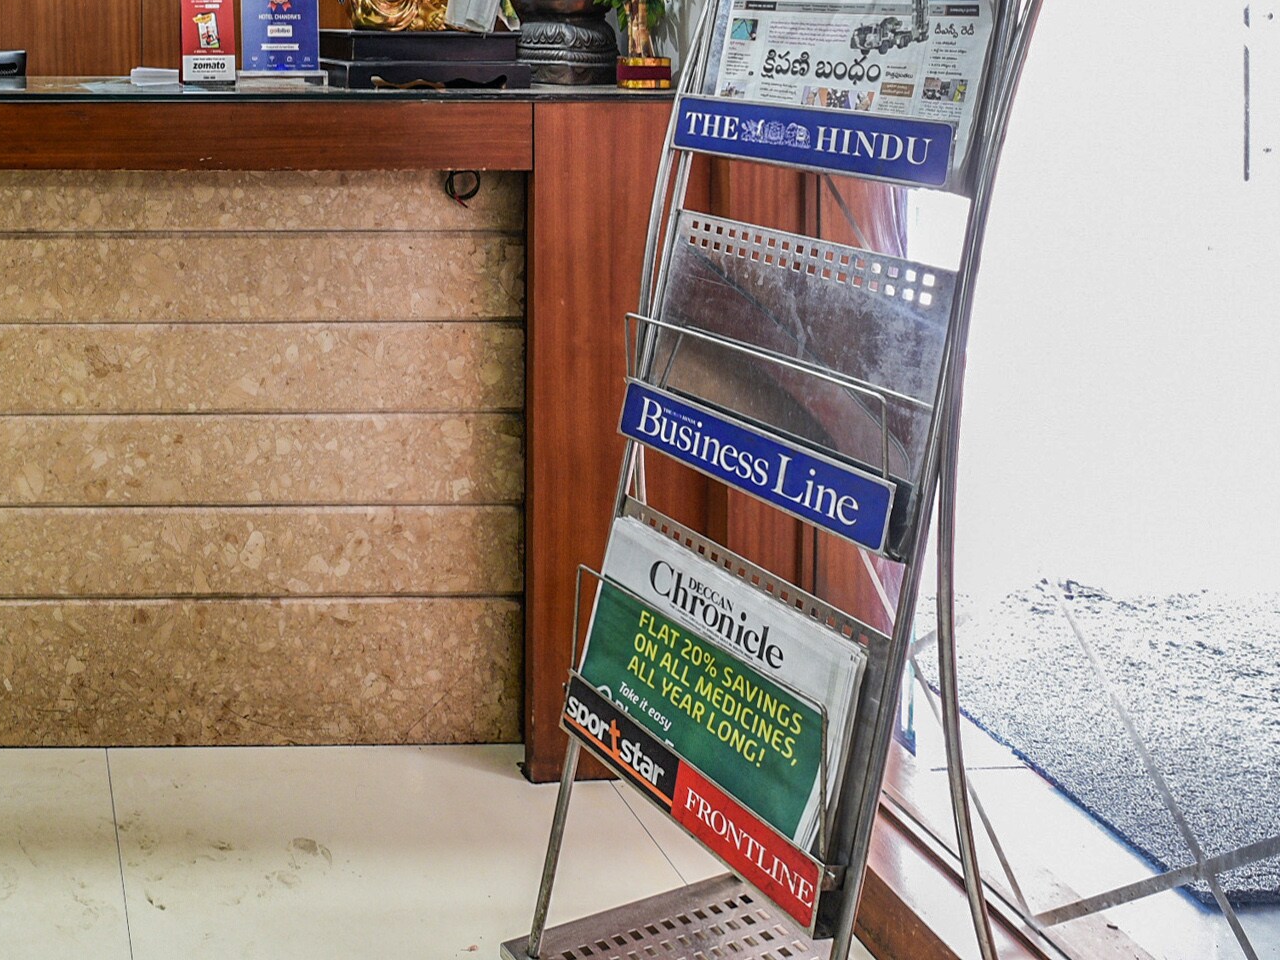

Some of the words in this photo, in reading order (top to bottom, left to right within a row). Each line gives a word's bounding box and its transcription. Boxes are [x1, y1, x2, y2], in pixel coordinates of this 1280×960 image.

[193, 61, 225, 69] zomato
[761, 48, 810, 80] క్షిపణి
[815, 55, 881, 85] బంధం
[685, 111, 739, 140] THE
[815, 125, 932, 165] HINDU
[650, 560, 784, 669] Chronicle
[688, 577, 734, 613] DECCAN
[618, 681, 639, 705] Take
[639, 697, 648, 712] it
[648, 708, 672, 732] easy
[627, 655, 655, 689] ALL
[662, 677, 706, 723] YEAR
[706, 712, 765, 768] LONG!
[634, 633, 658, 661] ON
[659, 652, 690, 687] ALL
[695, 675, 797, 767] MEDICINES,
[639, 610, 680, 649] FLAT
[681, 638, 718, 678] 20%
[721, 666, 803, 735] SAVINGS
[684, 787, 814, 908] FRONTLINE
